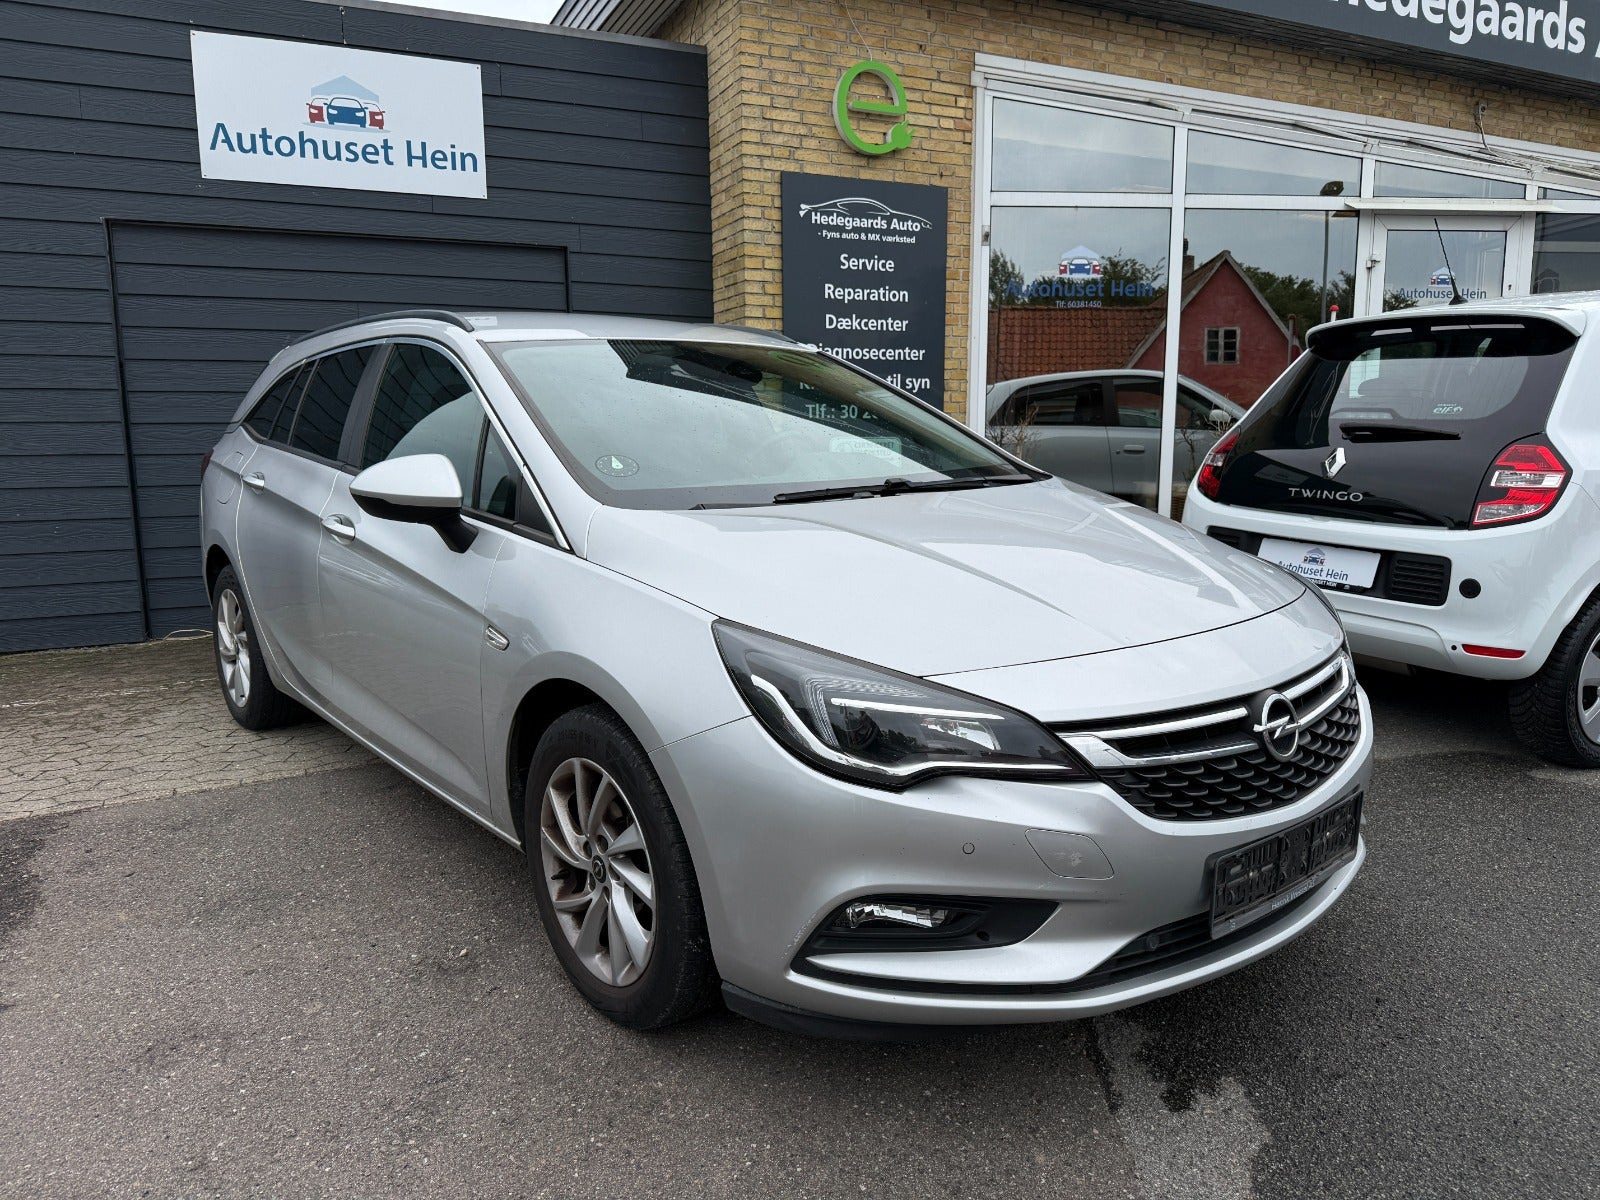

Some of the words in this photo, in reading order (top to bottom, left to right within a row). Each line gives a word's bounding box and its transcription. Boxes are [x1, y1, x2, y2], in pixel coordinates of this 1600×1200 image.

[1331, 0, 1586, 54] egaards
[209, 122, 395, 166] Autohuset
[405, 139, 478, 173] Hein
[811, 211, 887, 230] Hedegaards
[890, 217, 921, 232] Auto
[822, 229, 840, 240] Fyns
[841, 231, 859, 240] auto
[860, 232, 867, 241] &
[867, 232, 881, 241] MX
[882, 234, 916, 244] værksted
[839, 253, 895, 272] Service
[824, 283, 909, 304] Reparation
[1005, 279, 1104, 297] Autohuset
[1111, 280, 1153, 297] Hein
[1399, 287, 1453, 299] Autohuse
[1461, 287, 1487, 299] Hein
[825, 313, 909, 332] Dækcenter
[807, 342, 926, 361] iagnosecenter
[905, 375, 931, 393] syn
[805, 403, 836, 419] Tlf.:
[840, 404, 859, 419] 30
[1288, 487, 1363, 502] TWINGO
[1325, 568, 1349, 581] Hein
